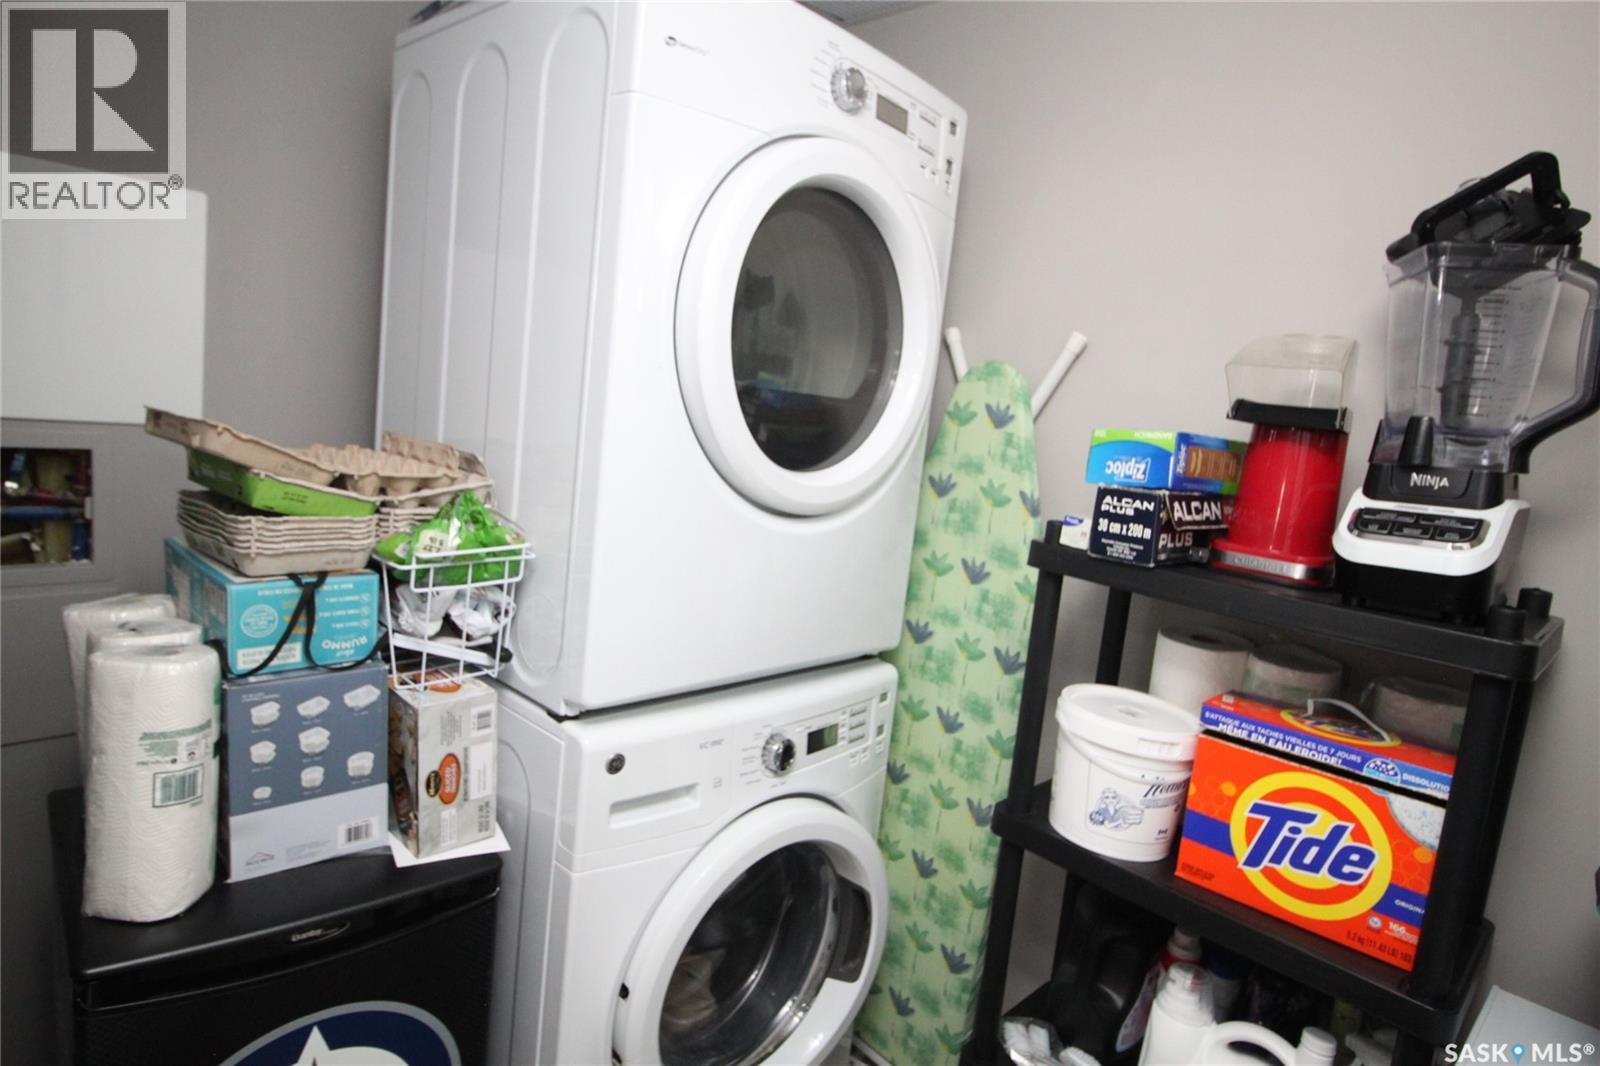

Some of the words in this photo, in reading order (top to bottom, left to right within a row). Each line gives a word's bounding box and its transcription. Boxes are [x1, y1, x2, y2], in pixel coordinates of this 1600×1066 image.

[1105, 457, 1146, 481] Ziploc
[1410, 471, 1449, 490] NINJA
[1101, 495, 1155, 512] ALCAN
[1101, 504, 1135, 516] PLUS
[1173, 501, 1222, 522] ALCAN
[1097, 517, 1108, 533] 30
[1108, 520, 1121, 535] cm
[1121, 524, 1127, 537] x
[1127, 522, 1144, 539] 200
[1143, 527, 1152, 540] m
[1158, 531, 1194, 549] PLUS
[1241, 719, 1257, 732] AUX
[1257, 723, 1285, 740] TACHES
[1285, 732, 1317, 749] VIEILLES
[1317, 742, 1329, 753] DE
[1329, 746, 1336, 755] 7
[1335, 748, 1362, 764] JOURS
[1249, 731, 1267, 746] EN
[1267, 736, 1293, 754] EAU
[1239, 800, 1378, 884] Tide
